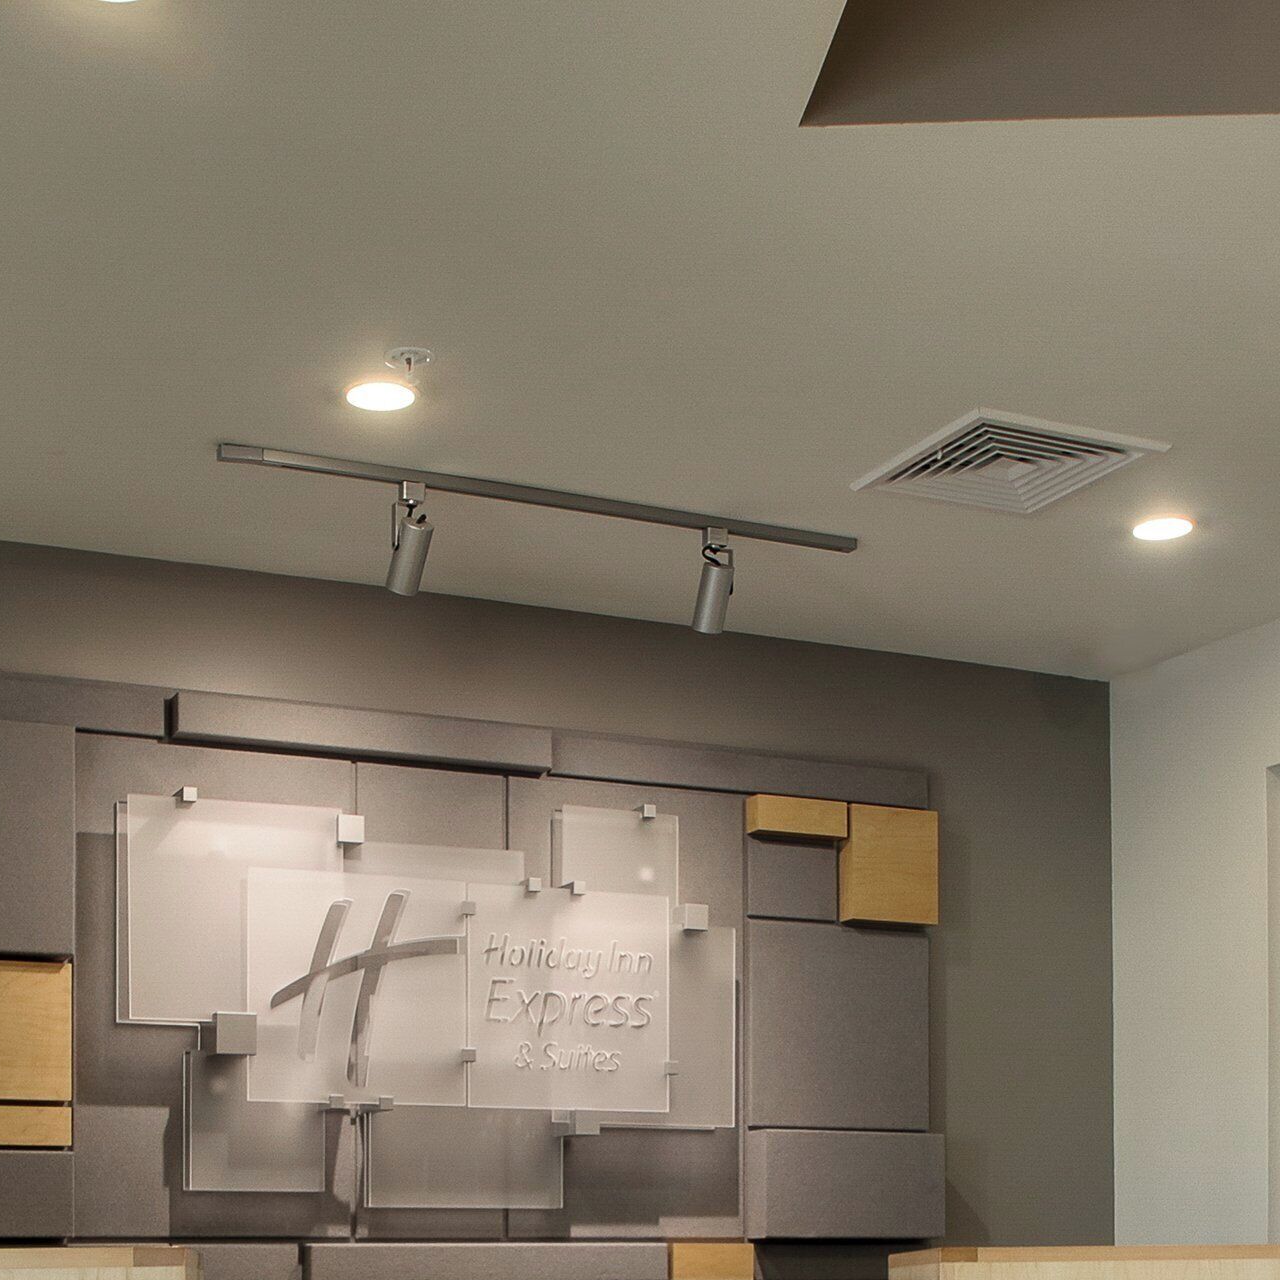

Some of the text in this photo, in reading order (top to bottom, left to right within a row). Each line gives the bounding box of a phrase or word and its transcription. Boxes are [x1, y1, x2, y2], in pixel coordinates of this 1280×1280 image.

[483, 932, 653, 979] Holiday Inn
[485, 976, 654, 1037] Express
[515, 1042, 622, 1072] & Suites
